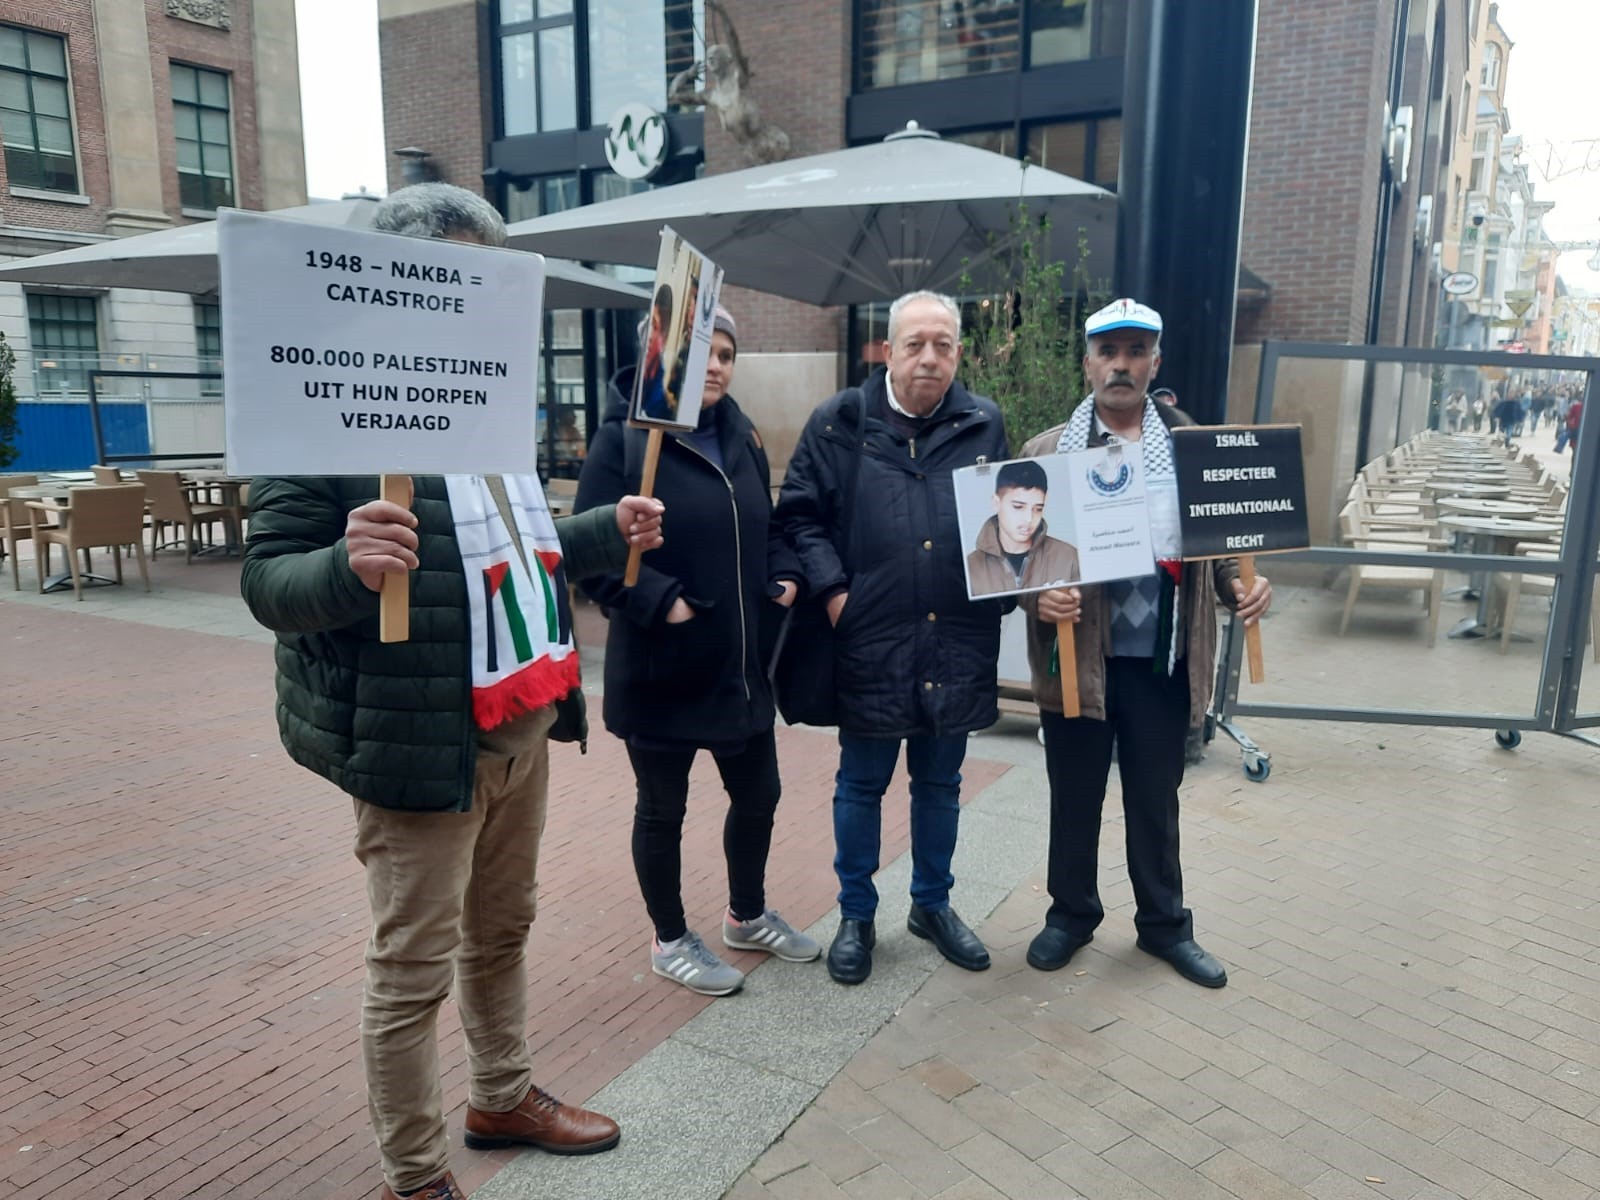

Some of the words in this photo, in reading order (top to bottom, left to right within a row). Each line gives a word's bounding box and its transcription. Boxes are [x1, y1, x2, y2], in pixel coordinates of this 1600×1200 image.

[306, 250, 362, 273] 1948
[392, 261, 462, 285] NAKBA
[327, 284, 464, 313] CATASTROFE
[271, 345, 364, 368] 800.000
[374, 353, 507, 377] PALESTIJNEN
[304, 381, 344, 399] UIT
[353, 384, 397, 401] HUN
[407, 387, 486, 405] DORPEN
[341, 412, 450, 430] VERJAAGD
[1215, 431, 1259, 447] ISRAËL
[1203, 467, 1276, 481] RESPECTEER
[1190, 499, 1294, 517] INTERNATIONAAL
[1227, 534, 1264, 548] RECHT
